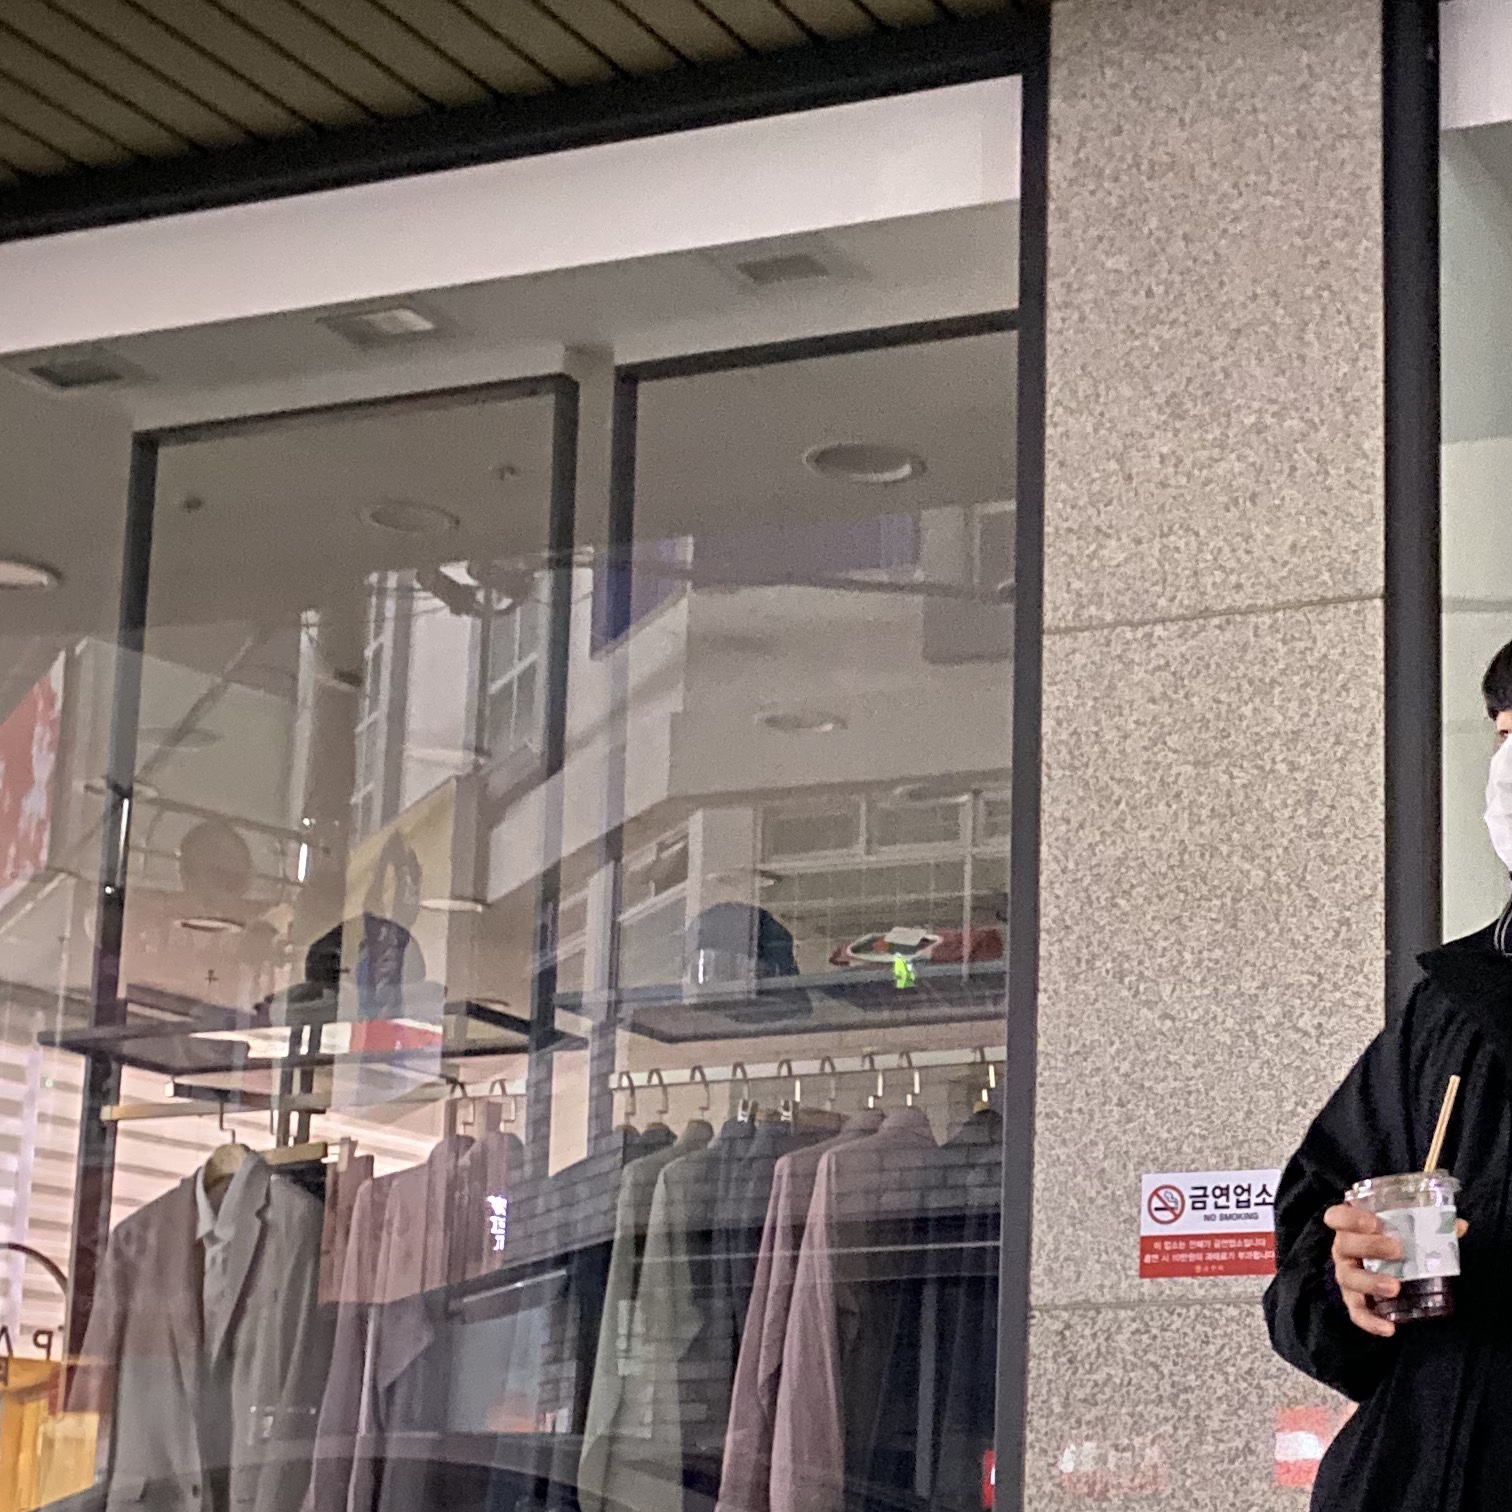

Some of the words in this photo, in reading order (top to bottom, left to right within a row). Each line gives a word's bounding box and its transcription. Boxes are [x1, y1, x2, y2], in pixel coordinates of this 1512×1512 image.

[1189, 1183, 1275, 1210] 금연업소
[1203, 1213, 1217, 1222] NO
[1219, 1212, 1259, 1221] SMOKING
